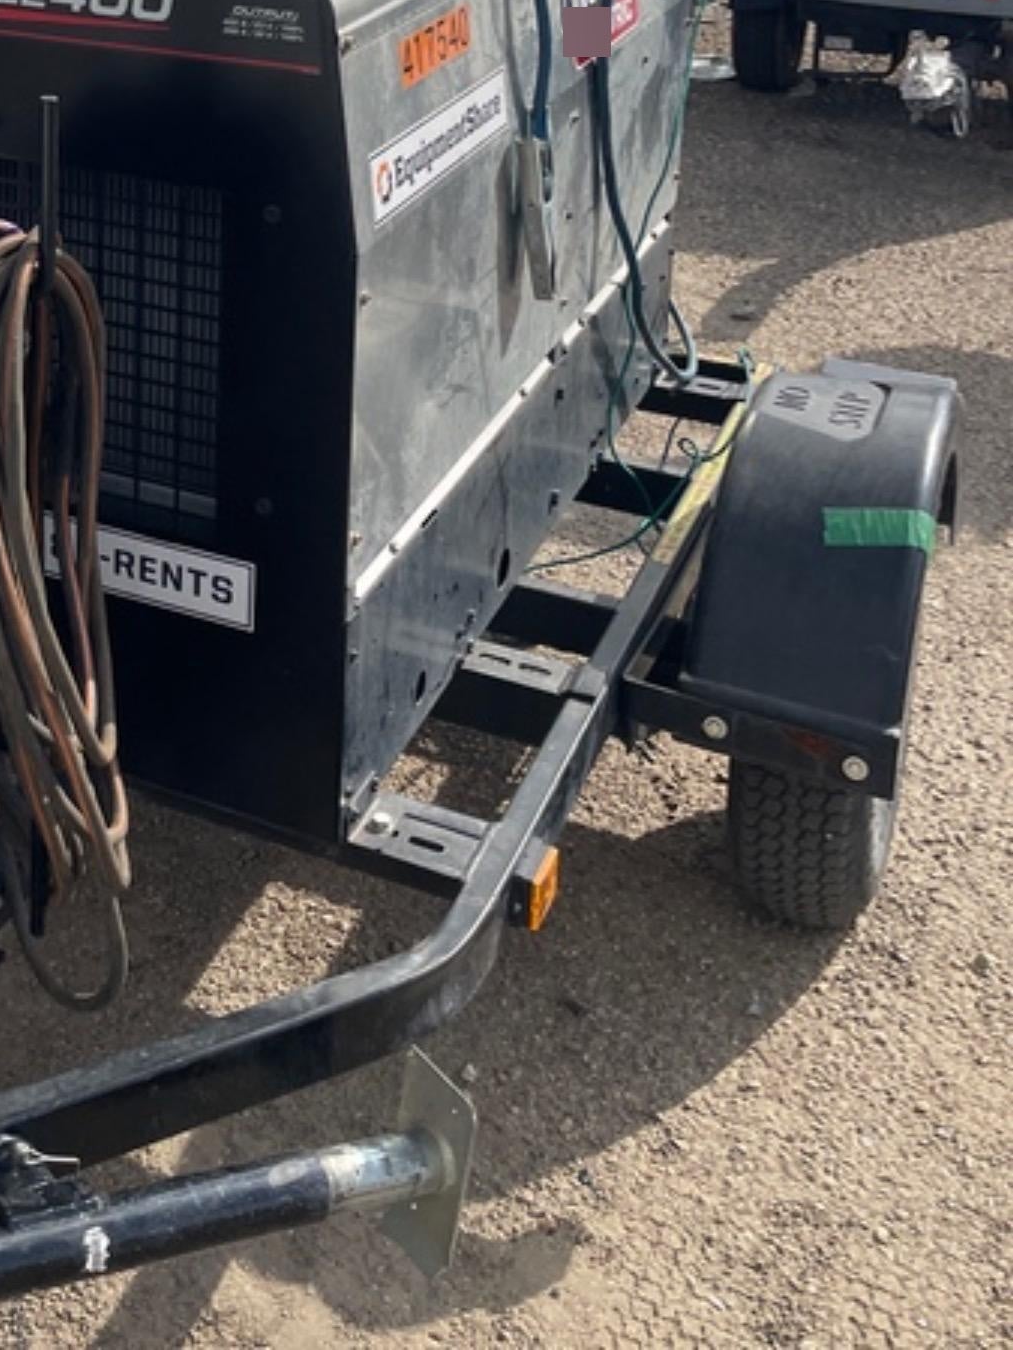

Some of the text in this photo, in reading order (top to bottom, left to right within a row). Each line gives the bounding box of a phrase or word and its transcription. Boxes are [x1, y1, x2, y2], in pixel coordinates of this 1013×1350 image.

[402, 5, 469, 79] 417540
[393, 93, 501, 189] EquipmentShare
[52, 534, 234, 606] -RENTS
